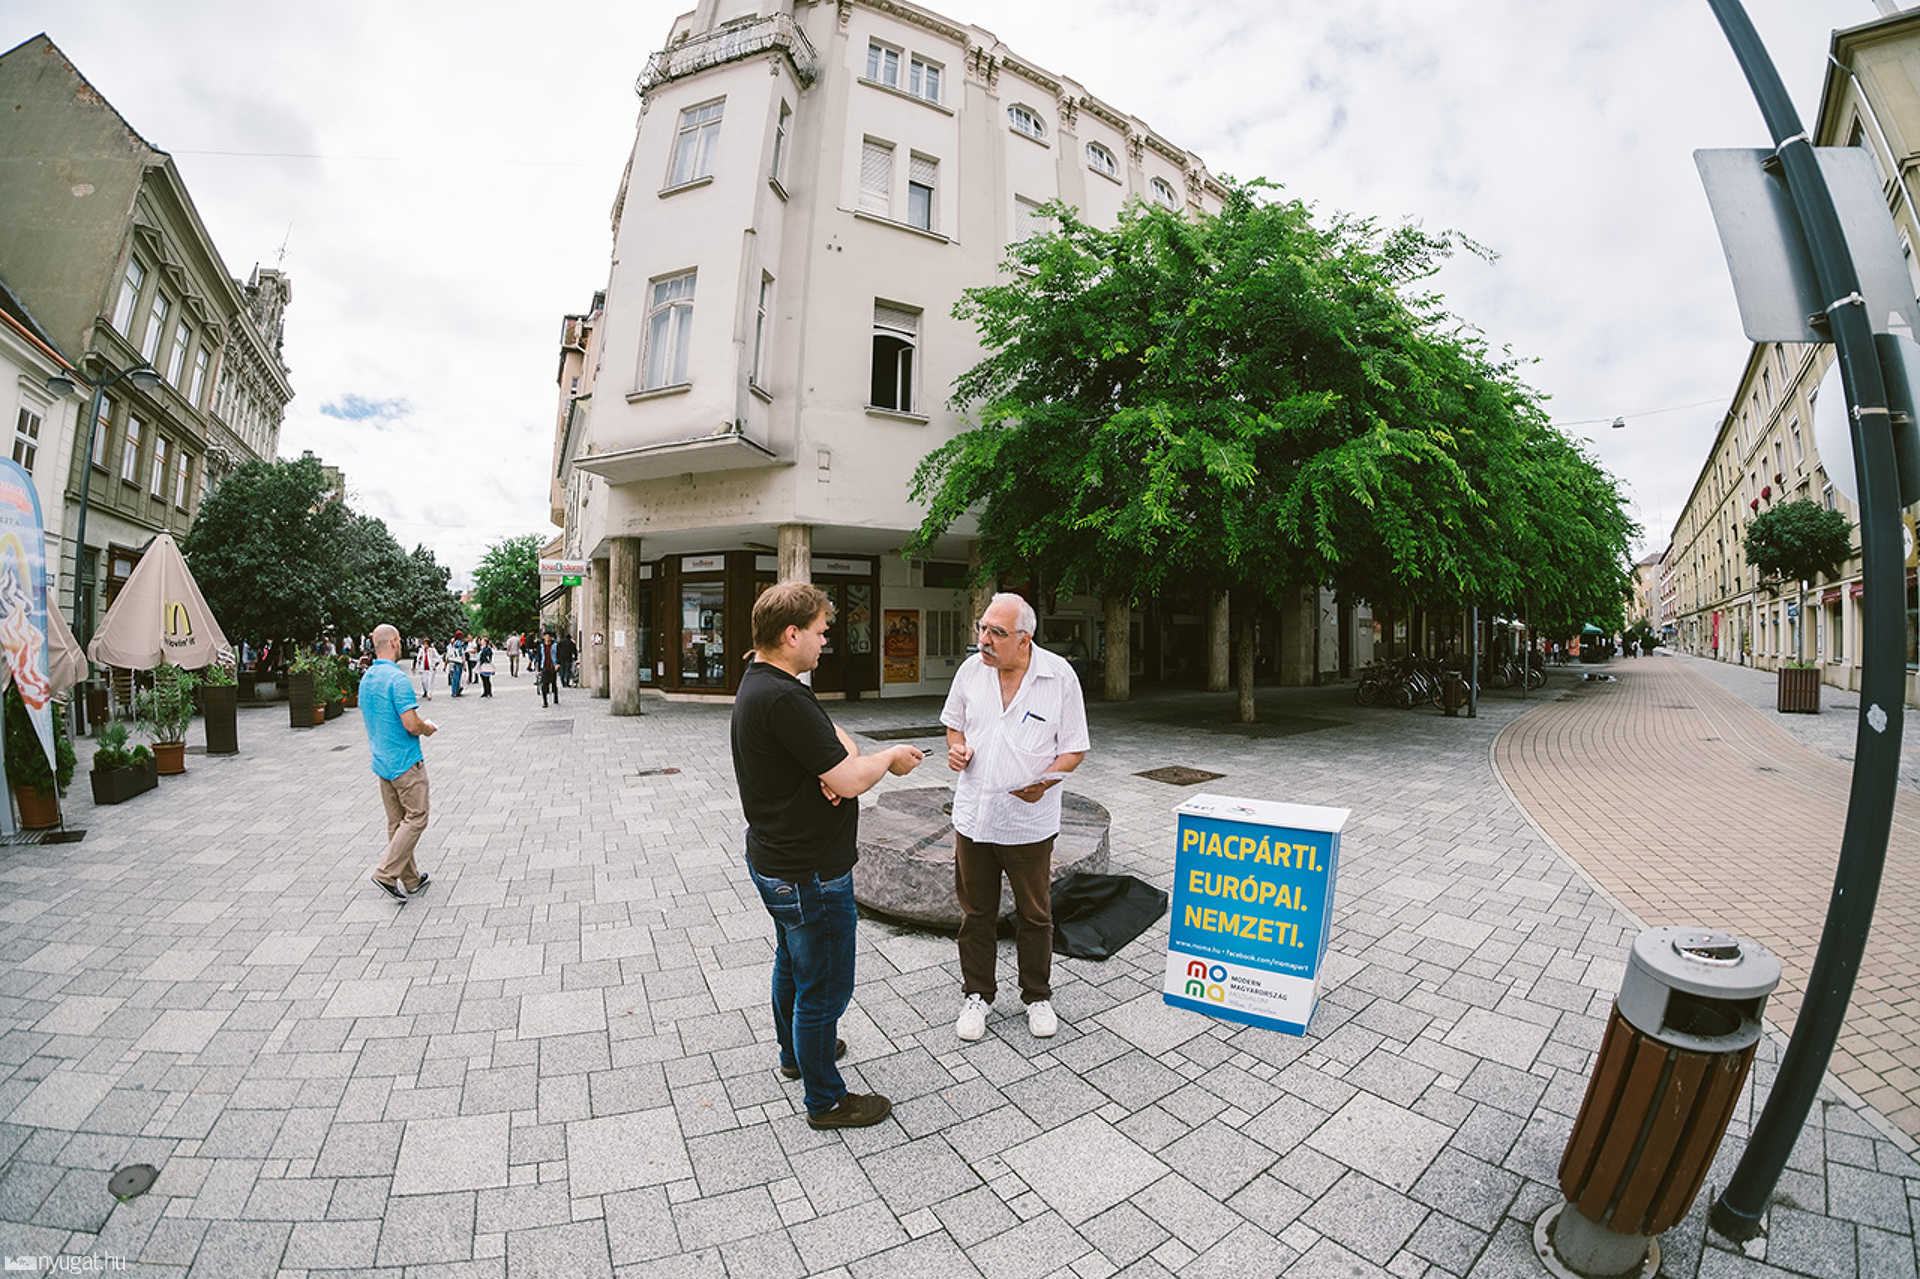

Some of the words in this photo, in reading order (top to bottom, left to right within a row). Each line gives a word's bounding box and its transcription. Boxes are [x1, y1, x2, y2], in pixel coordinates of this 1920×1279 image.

[1183, 829, 1323, 872] PIACPÁRTI.
[1189, 869, 1308, 911] EURÓPAI.
[1184, 905, 1304, 948] NEMZETI.
[1231, 975, 1261, 987] MODERN
